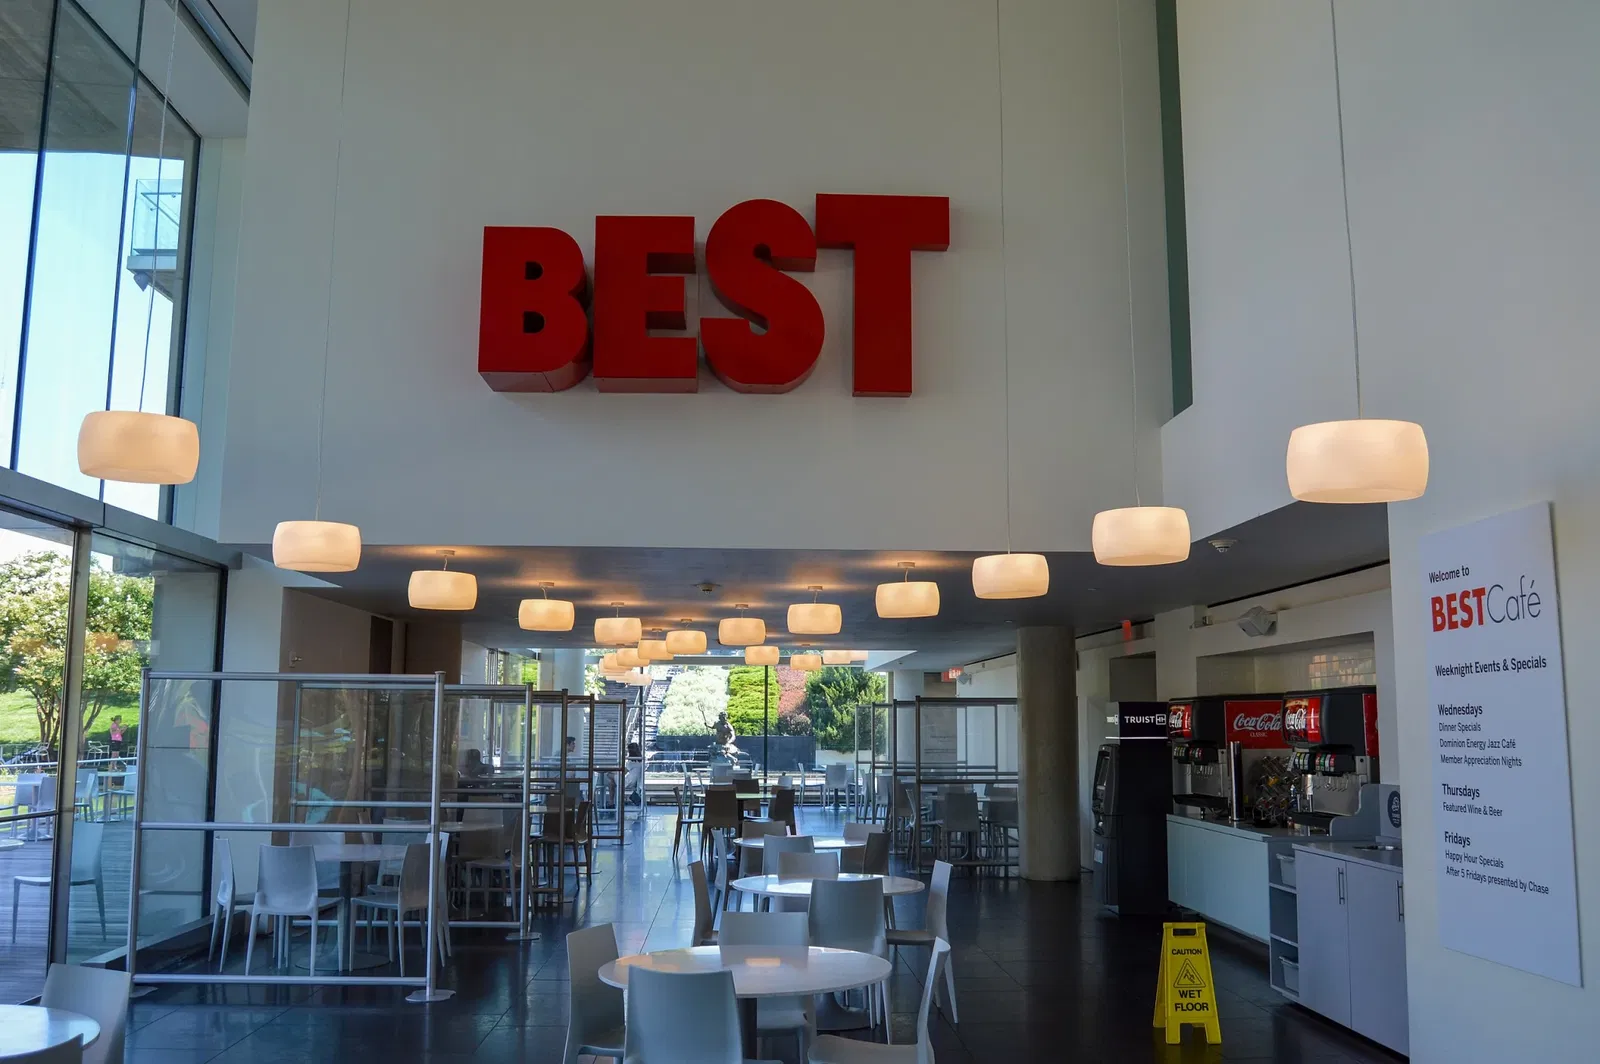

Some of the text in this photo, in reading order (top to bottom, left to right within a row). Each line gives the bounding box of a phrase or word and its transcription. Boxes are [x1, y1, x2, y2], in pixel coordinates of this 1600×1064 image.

[478, 193, 950, 397] BEST
[1429, 565, 1470, 584] Welcome to
[1435, 655, 1547, 678] Weeknight Events & Specials
[1438, 703, 1483, 717] Wednesdays
[1124, 715, 1155, 724] TRUIST
[1233, 712, 1283, 732] Coca-Cola
[1438, 721, 1481, 734] Dinner Specials
[1439, 738, 1516, 751] Dominion Energy Jazz Café
[1440, 755, 1522, 769] Member Appreciation Nights
[1442, 783, 1480, 800] Thursdays
[1443, 802, 1503, 817] Featured Wine & Beer
[1444, 831, 1471, 848] Fridays
[1445, 850, 1504, 869] Happy Hour Specials
[1446, 866, 1549, 895] After 5 Fridays presented by Chase
[1178, 990, 1202, 998] WET
[1174, 1003, 1209, 1012] FLOOR
